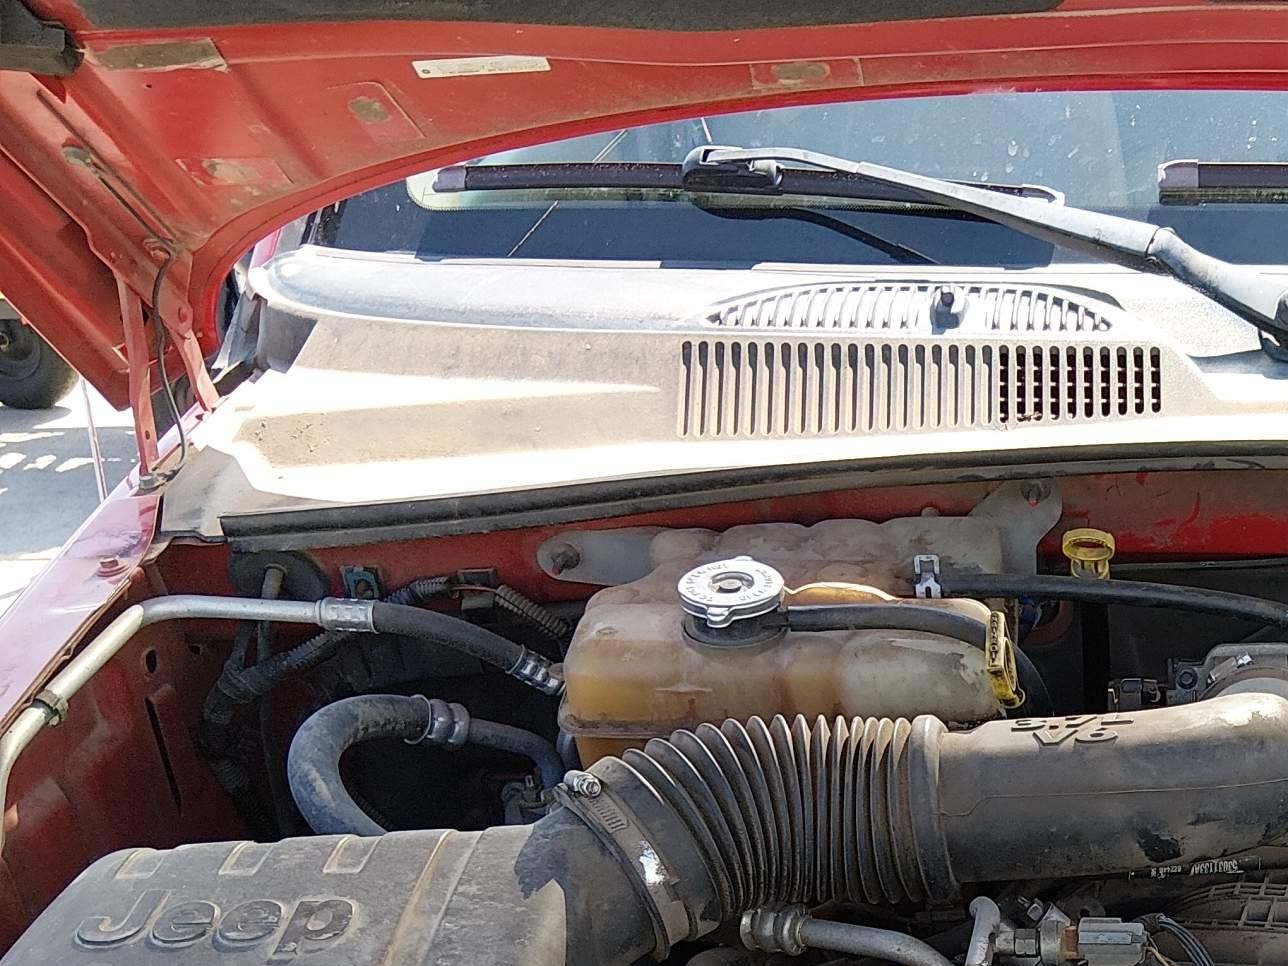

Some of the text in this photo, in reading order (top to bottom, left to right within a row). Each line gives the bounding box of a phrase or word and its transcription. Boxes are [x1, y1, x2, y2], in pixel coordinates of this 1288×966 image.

[1010, 714, 1135, 733] 3.7L
[1032, 727, 1119, 747] V6
[73, 888, 358, 958] Jeep
